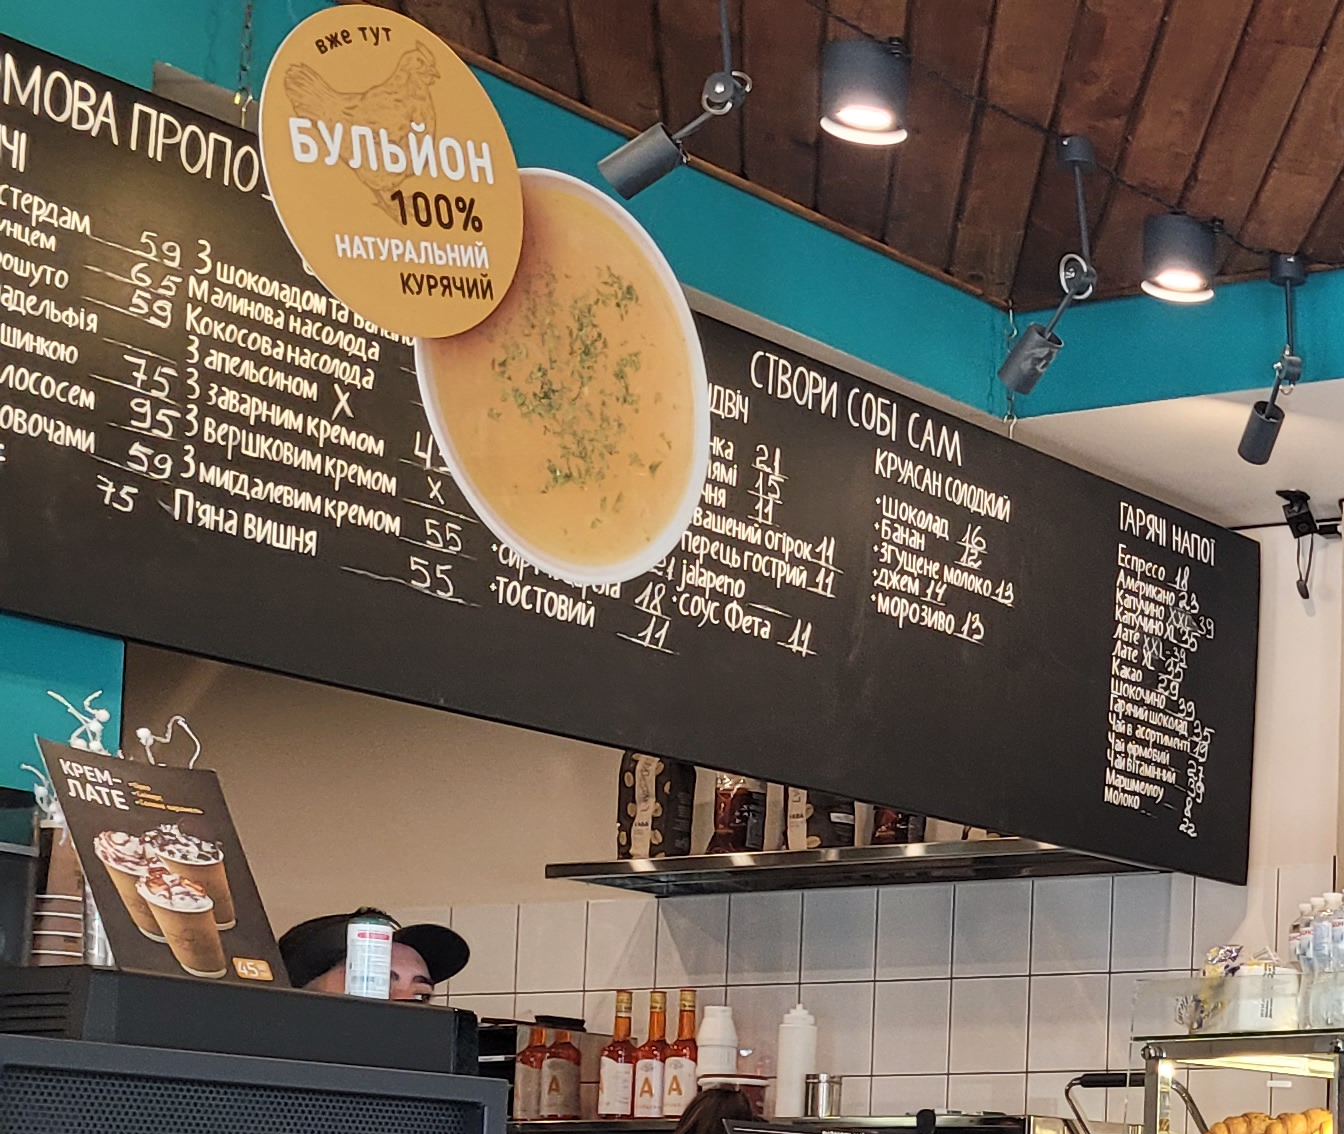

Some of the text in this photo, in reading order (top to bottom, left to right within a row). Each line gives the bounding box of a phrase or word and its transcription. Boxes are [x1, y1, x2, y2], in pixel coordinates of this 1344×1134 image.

[2, 53, 262, 193] МОВА ПРОПО
[289, 117, 494, 185] БУЛЬЙОН
[0, 184, 181, 268] стердам 59
[390, 190, 484, 233] 100%
[335, 234, 490, 269] НАТУРАЛЬНИЙ
[0, 252, 173, 328] ошуто 59
[131, 263, 183, 296] 65
[216, 261, 326, 316] шоколадом
[400, 272, 494, 300] КУРЯЧИЙ
[0, 284, 99, 333] адельфія
[188, 275, 284, 330] Малинова
[289, 314, 380, 362] насолода
[186, 303, 375, 390] Кокосова насолода
[123, 354, 178, 399] 75
[204, 350, 318, 401] апельсином
[130, 398, 181, 439] 95
[206, 383, 303, 434] заварним
[306, 415, 385, 457] кремом
[413, 431, 449, 473] 4
[750, 351, 962, 467] СТВОРИ СОБІ САМ
[127, 442, 173, 479] 59
[203, 417, 322, 472] вершковим
[324, 457, 397, 497] кремом
[755, 444, 781, 475] 21
[97, 474, 139, 512] 75
[755, 472, 785, 500] 15
[874, 448, 1011, 523] КРУАСАН СОЛОДКИЙ
[199, 461, 322, 515] мигдалевим
[324, 498, 401, 537] кремом
[425, 518, 463, 553] 55
[754, 496, 774, 524] 11
[693, 506, 836, 566] вашений огірок 11
[961, 523, 987, 552] 16
[1120, 502, 1216, 567] ГАРЯЧІ НАПОЇ
[243, 512, 319, 557] вишня
[409, 556, 455, 598] 55
[743, 551, 808, 588] гострий
[816, 567, 836, 597] 11
[959, 546, 982, 569] 12
[1117, 543, 1190, 591] Еспресо 18
[676, 559, 746, 599] jalapeno
[925, 580, 948, 602] 14
[943, 565, 992, 597] молоко
[994, 579, 1015, 605] 13
[1116, 568, 1176, 607] Американо
[634, 582, 666, 615] 18
[1115, 588, 1165, 620] Капучино
[638, 616, 670, 648] 11
[679, 593, 721, 628] соус
[788, 619, 812, 657] 11
[961, 611, 985, 640] 13
[1113, 623, 1140, 645] Лате
[1114, 605, 1164, 637] Капучино
[1111, 656, 1143, 683] Какао
[1112, 640, 1138, 664] Лате
[1107, 731, 1126, 752] Чай
[1108, 712, 1126, 733] Чай
[58, 758, 123, 786] КРЕМ-
[1106, 748, 1126, 771] Чай
[66, 778, 130, 811] ЛАТЕ
[1103, 785, 1140, 809] Молоко
[238, 960, 259, 977] 45
